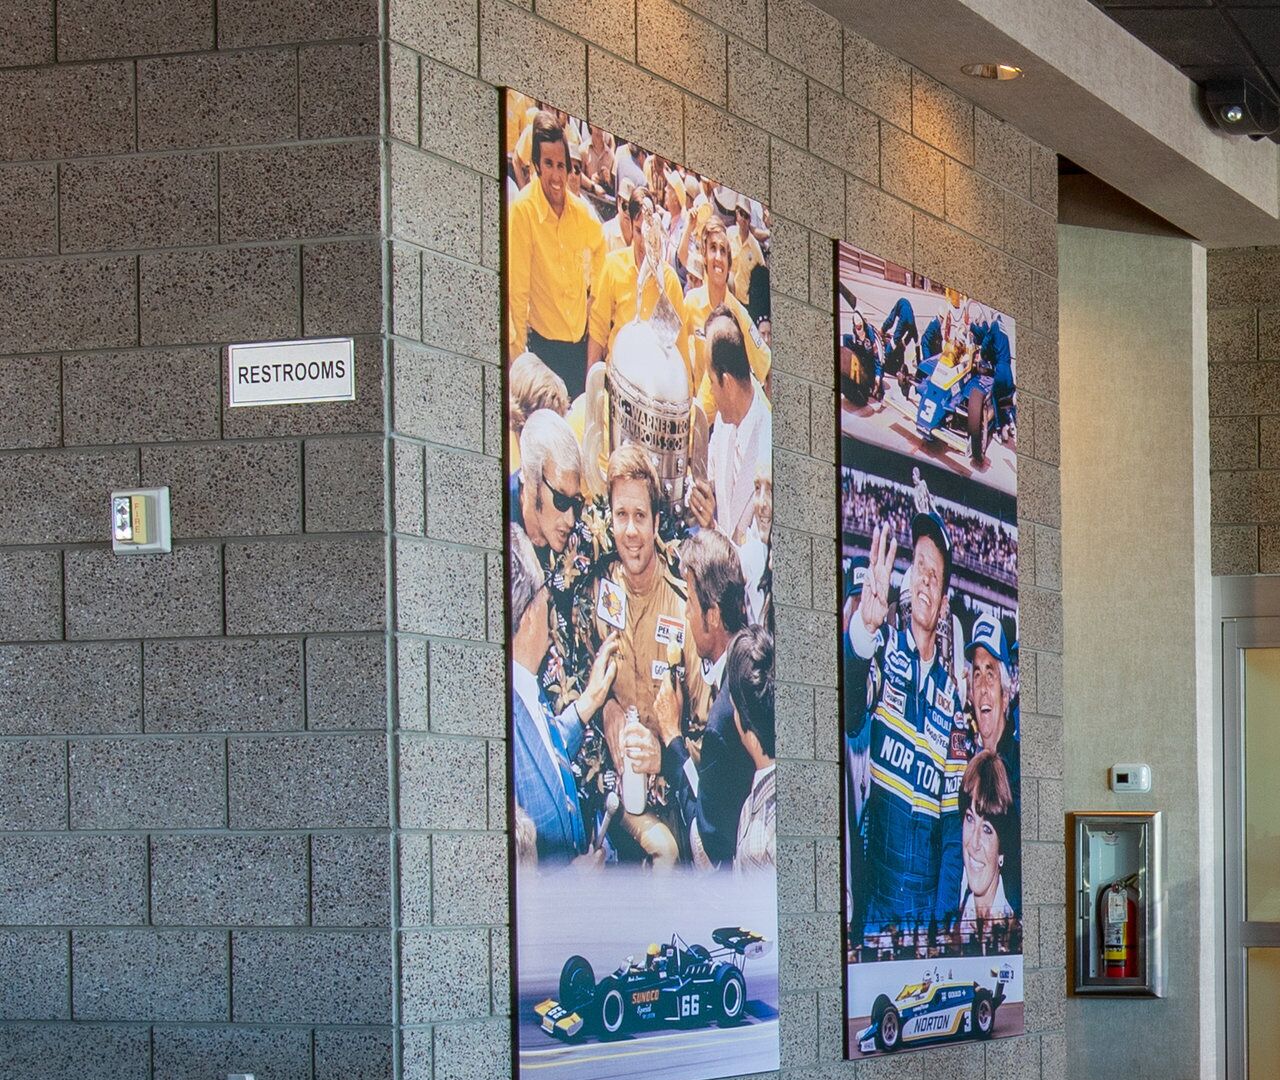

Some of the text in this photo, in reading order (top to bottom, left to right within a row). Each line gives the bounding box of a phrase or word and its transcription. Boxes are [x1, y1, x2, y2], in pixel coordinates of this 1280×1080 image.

[237, 359, 346, 384] RESTROOMS
[631, 989, 660, 1004] SUNOCO
[681, 994, 700, 1017] 66
[913, 1014, 951, 1034] NORTON
